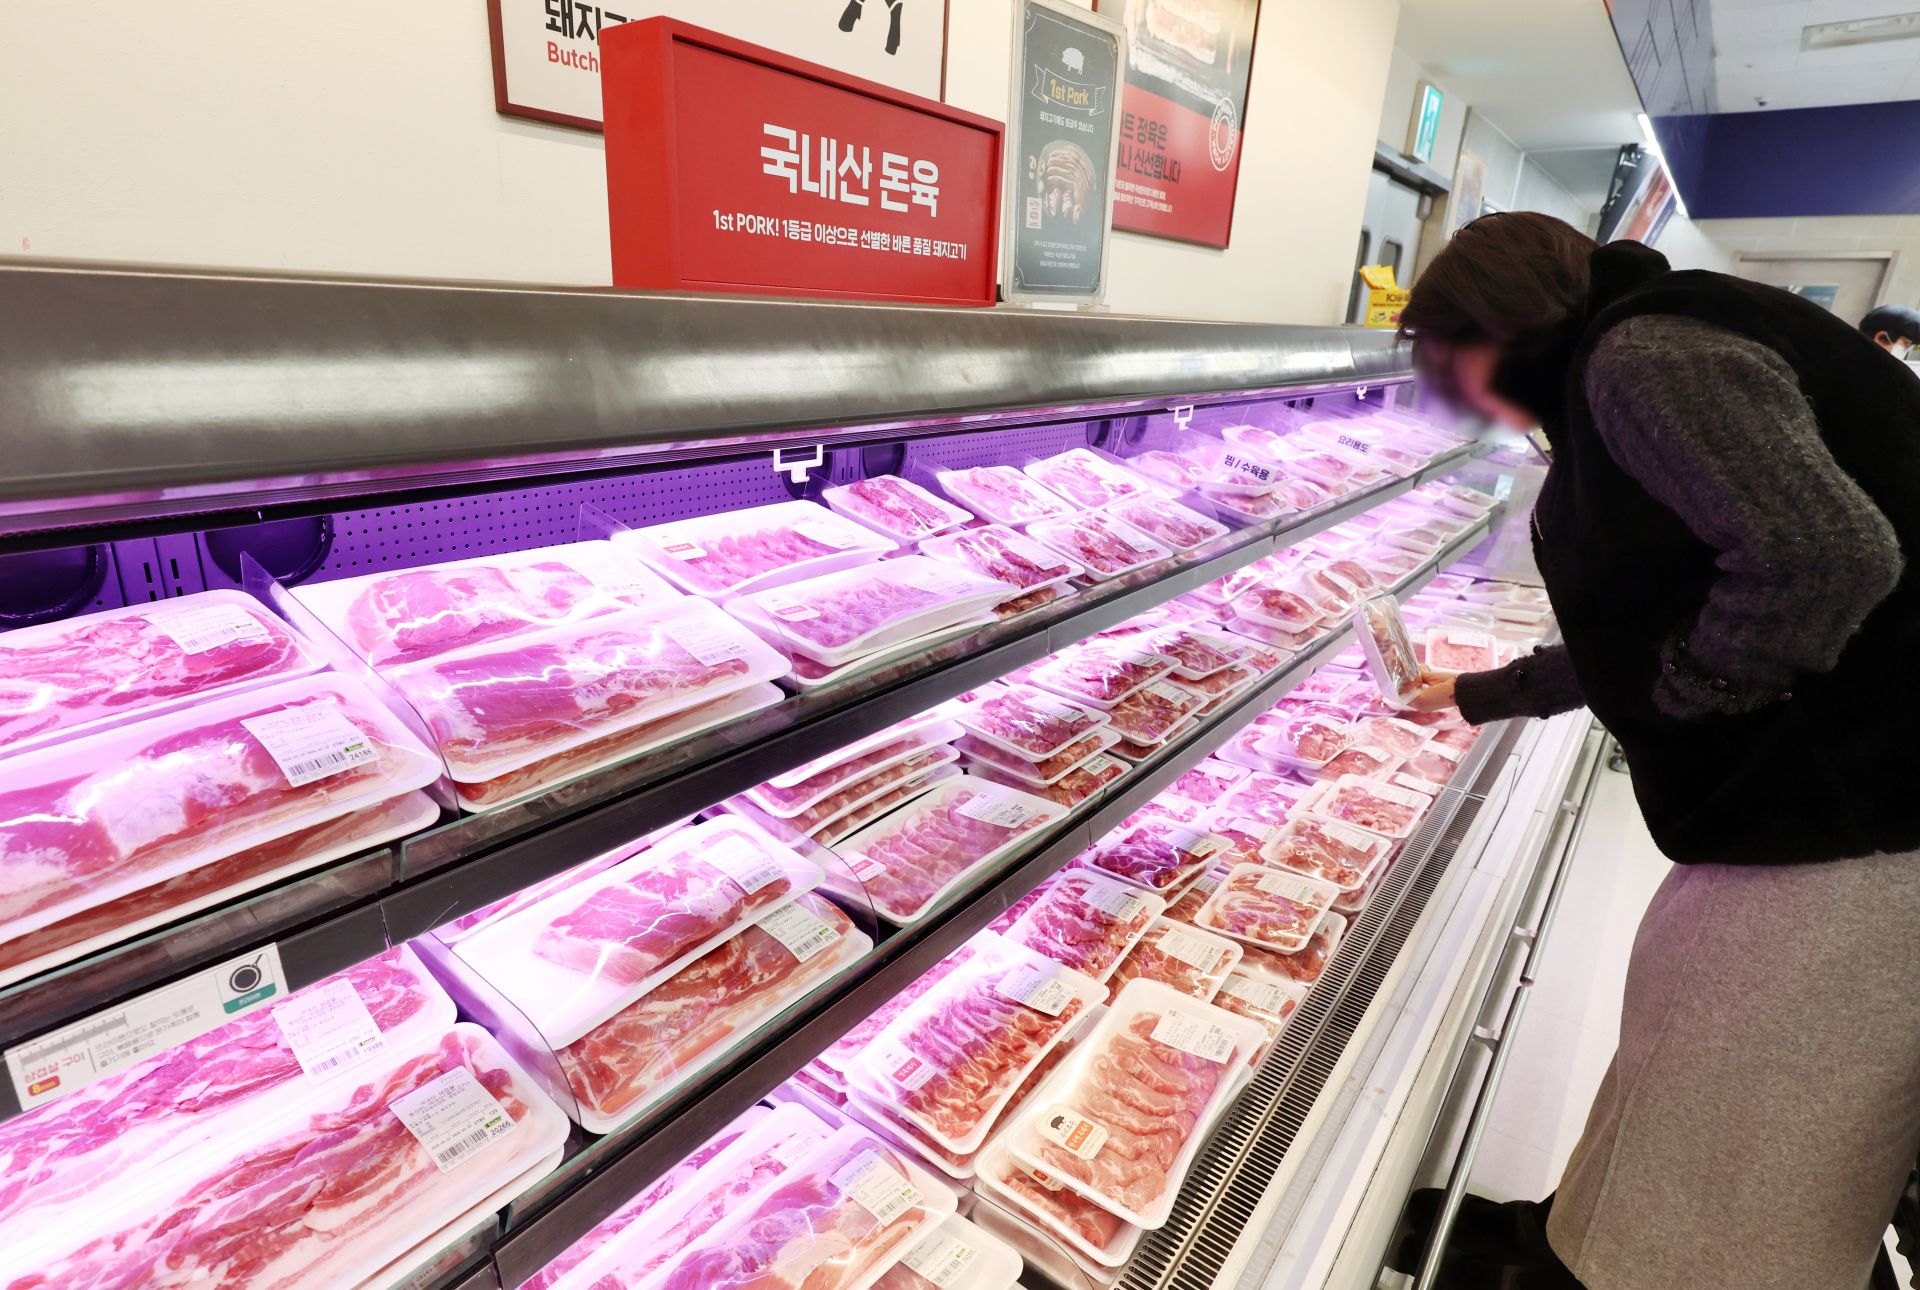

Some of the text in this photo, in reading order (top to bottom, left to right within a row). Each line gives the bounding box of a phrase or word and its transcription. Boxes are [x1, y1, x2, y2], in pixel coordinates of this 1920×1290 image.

[545, 0, 635, 46] 돼지
[547, 41, 600, 73] Butch
[1051, 79, 1089, 105] 1st Pork
[1119, 112, 1168, 151] 트 정육은
[760, 122, 940, 218] 국내산 돈육
[1134, 147, 1181, 185] 신선합니다
[712, 209, 967, 261] 1st PORK! 1등급 이상으로 선별한 바른 품질 돼지고기
[1337, 434, 1370, 454] 요리용도
[1224, 454, 1236, 467] 찜
[1241, 461, 1270, 482] 수육용
[490, 1120, 512, 1137] 20266
